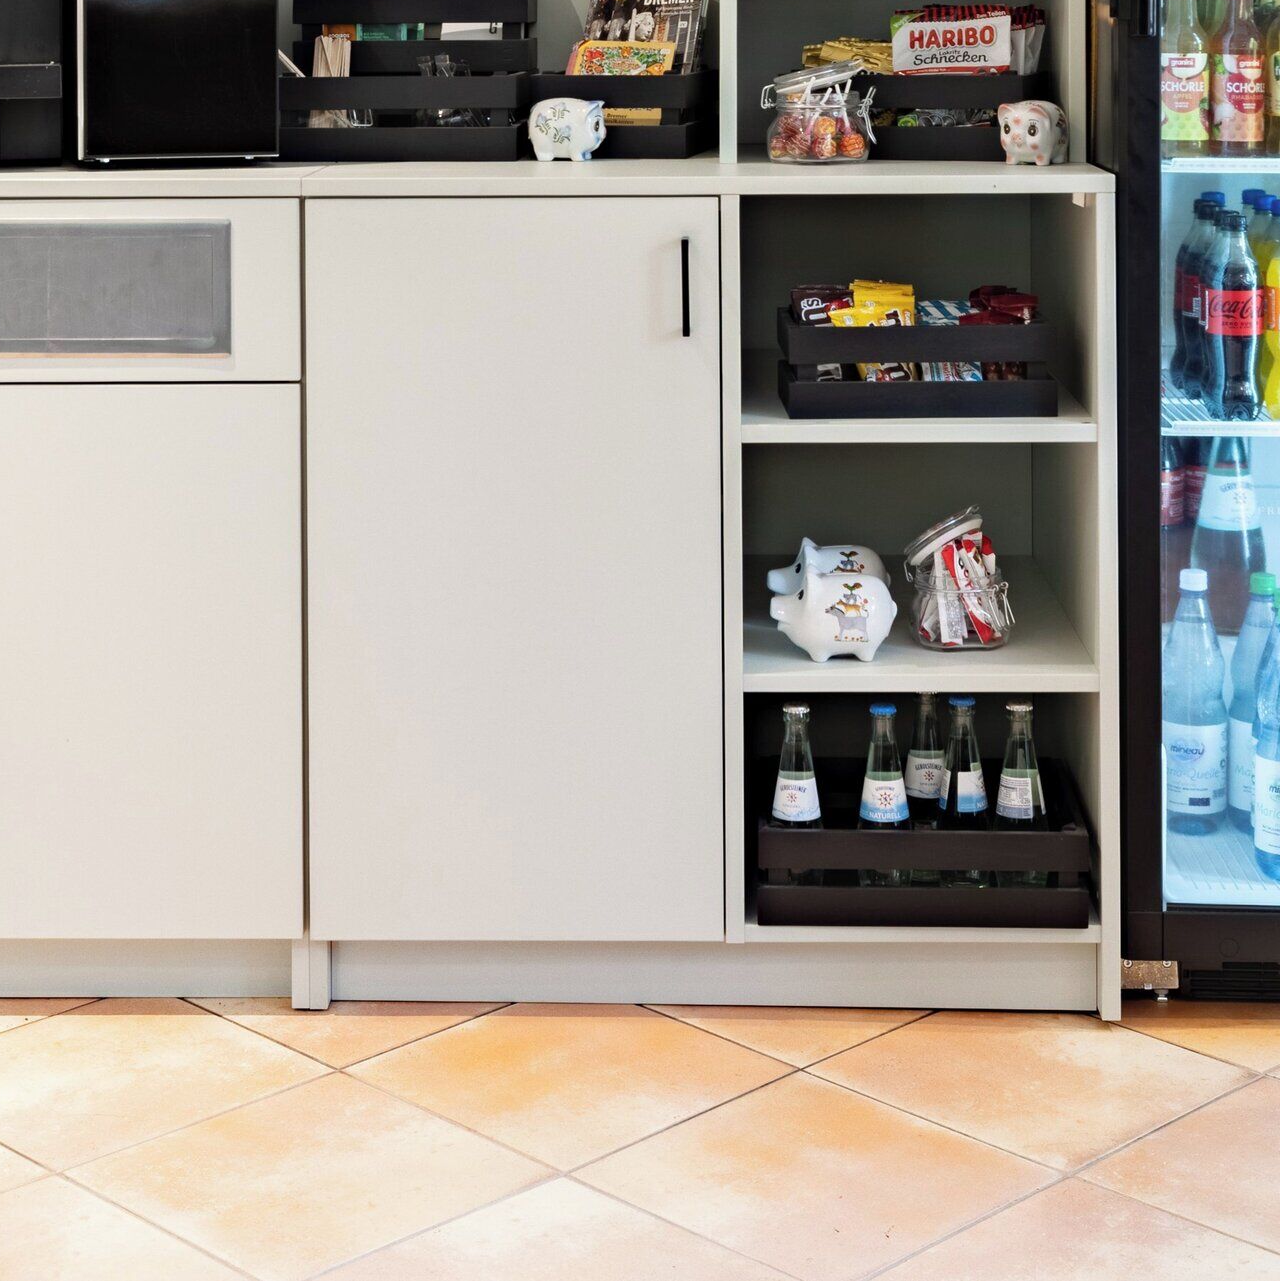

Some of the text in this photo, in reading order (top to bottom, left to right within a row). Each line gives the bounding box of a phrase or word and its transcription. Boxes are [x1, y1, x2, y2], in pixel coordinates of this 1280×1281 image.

[909, 25, 996, 50] HARIBO
[913, 51, 989, 66] Schnecken
[1161, 81, 1205, 92] SCHORLE
[1170, 745, 1205, 756] mineau
[869, 811, 901, 819] NATURELL
